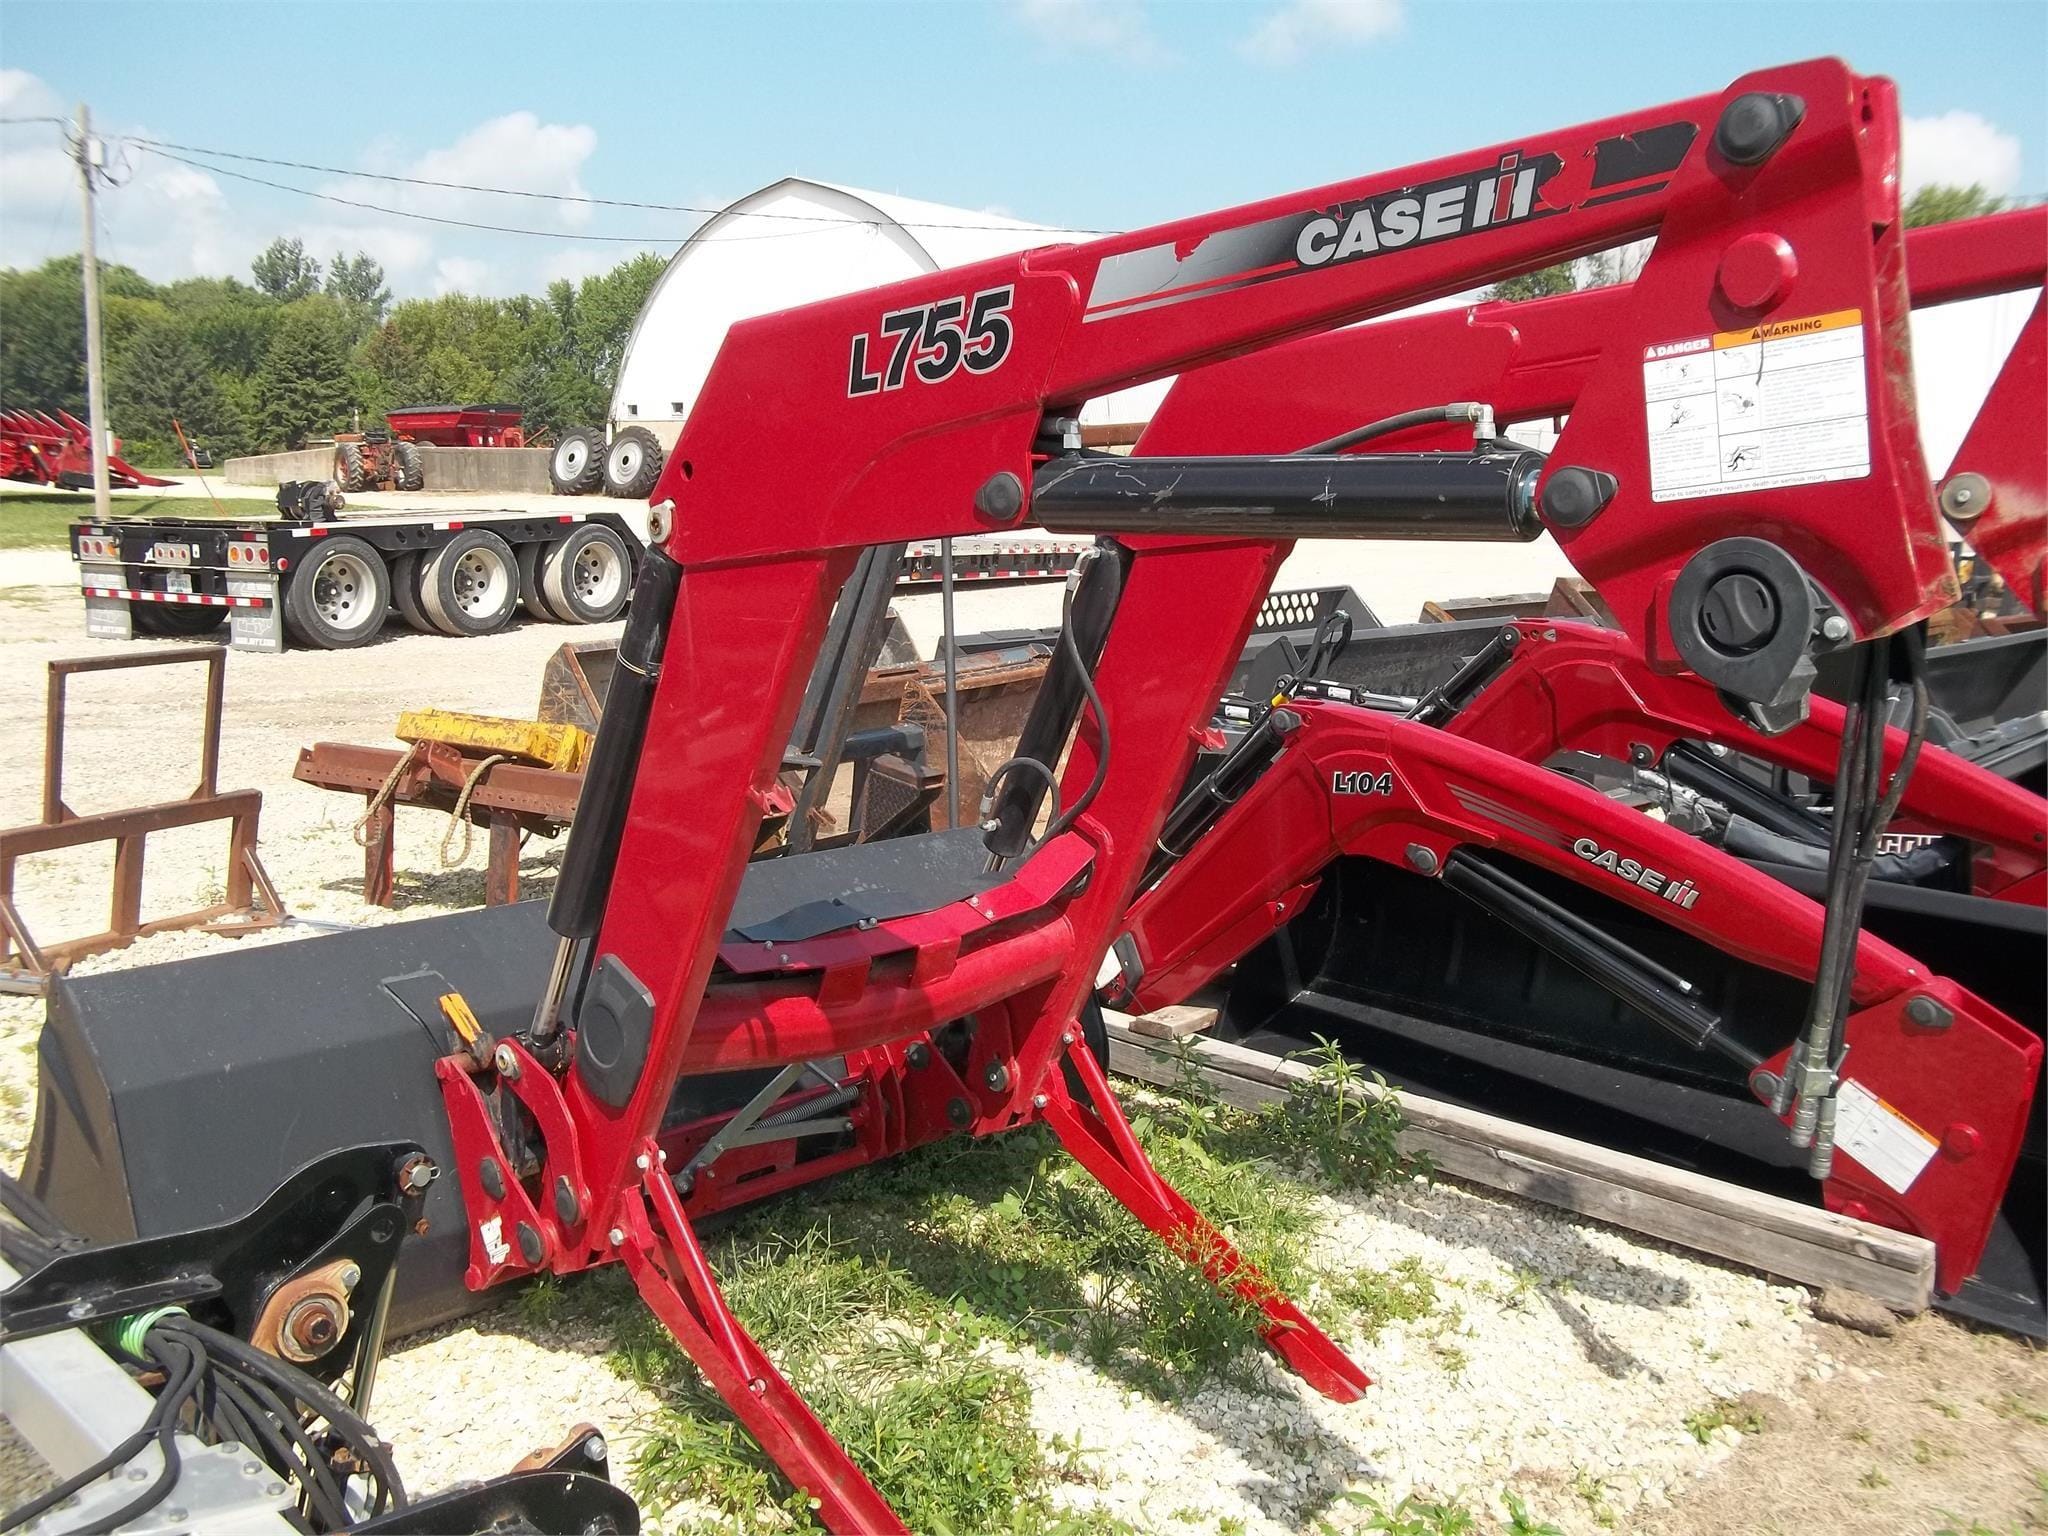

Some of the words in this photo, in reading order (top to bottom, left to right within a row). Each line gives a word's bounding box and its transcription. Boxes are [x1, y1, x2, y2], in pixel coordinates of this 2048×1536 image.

[1296, 185, 1467, 266] CASE
[847, 284, 1035, 398] L755
[1656, 338, 1711, 358] DANGER
[1761, 319, 1823, 338] WARNING
[1332, 771, 1393, 796] L104
[1573, 837, 1668, 896] CASE
